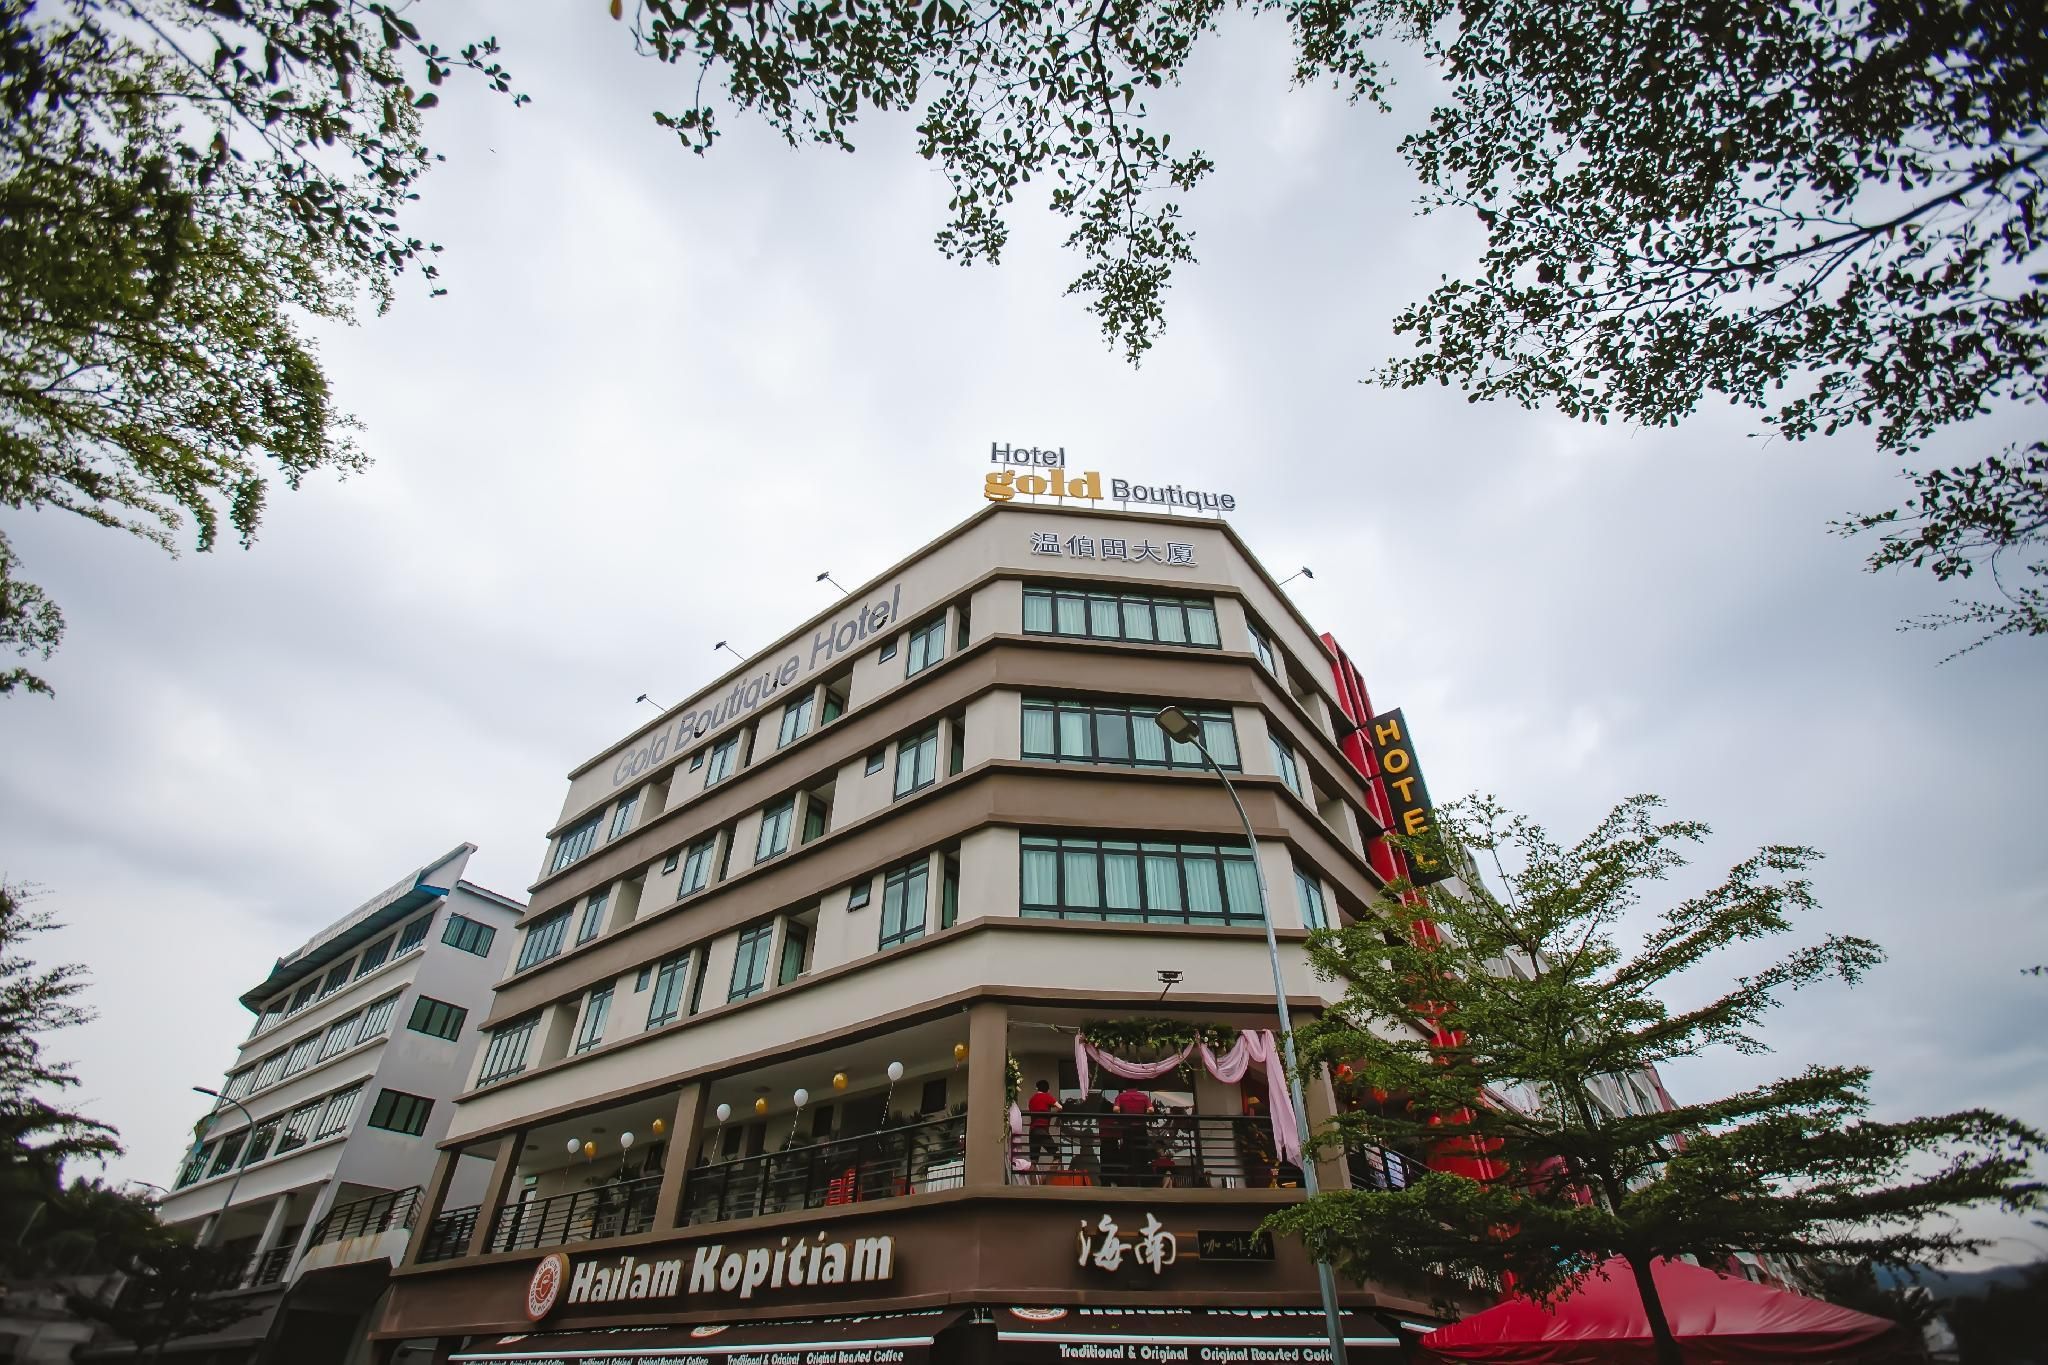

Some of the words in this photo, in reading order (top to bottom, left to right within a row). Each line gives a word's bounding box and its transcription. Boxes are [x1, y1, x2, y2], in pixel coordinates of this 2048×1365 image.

[991, 442, 1065, 467] Hotel
[984, 468, 1104, 501] gold
[1112, 479, 1236, 511] Boutique
[613, 725, 672, 787] Gold
[674, 654, 800, 752] Boutique
[808, 583, 901, 670] Hotel
[1079, 1212, 1176, 1274] 海南
[568, 1255, 683, 1303] Hailam
[688, 1231, 895, 1298] Kopitiam
[874, 1349, 904, 1362] Coffee
[1060, 1344, 1124, 1358] Traditional
[1128, 1345, 1137, 1359] &
[1140, 1346, 1189, 1363] Original
[1201, 1347, 1248, 1364] Original
[1250, 1348, 1299, 1361] Roasted
